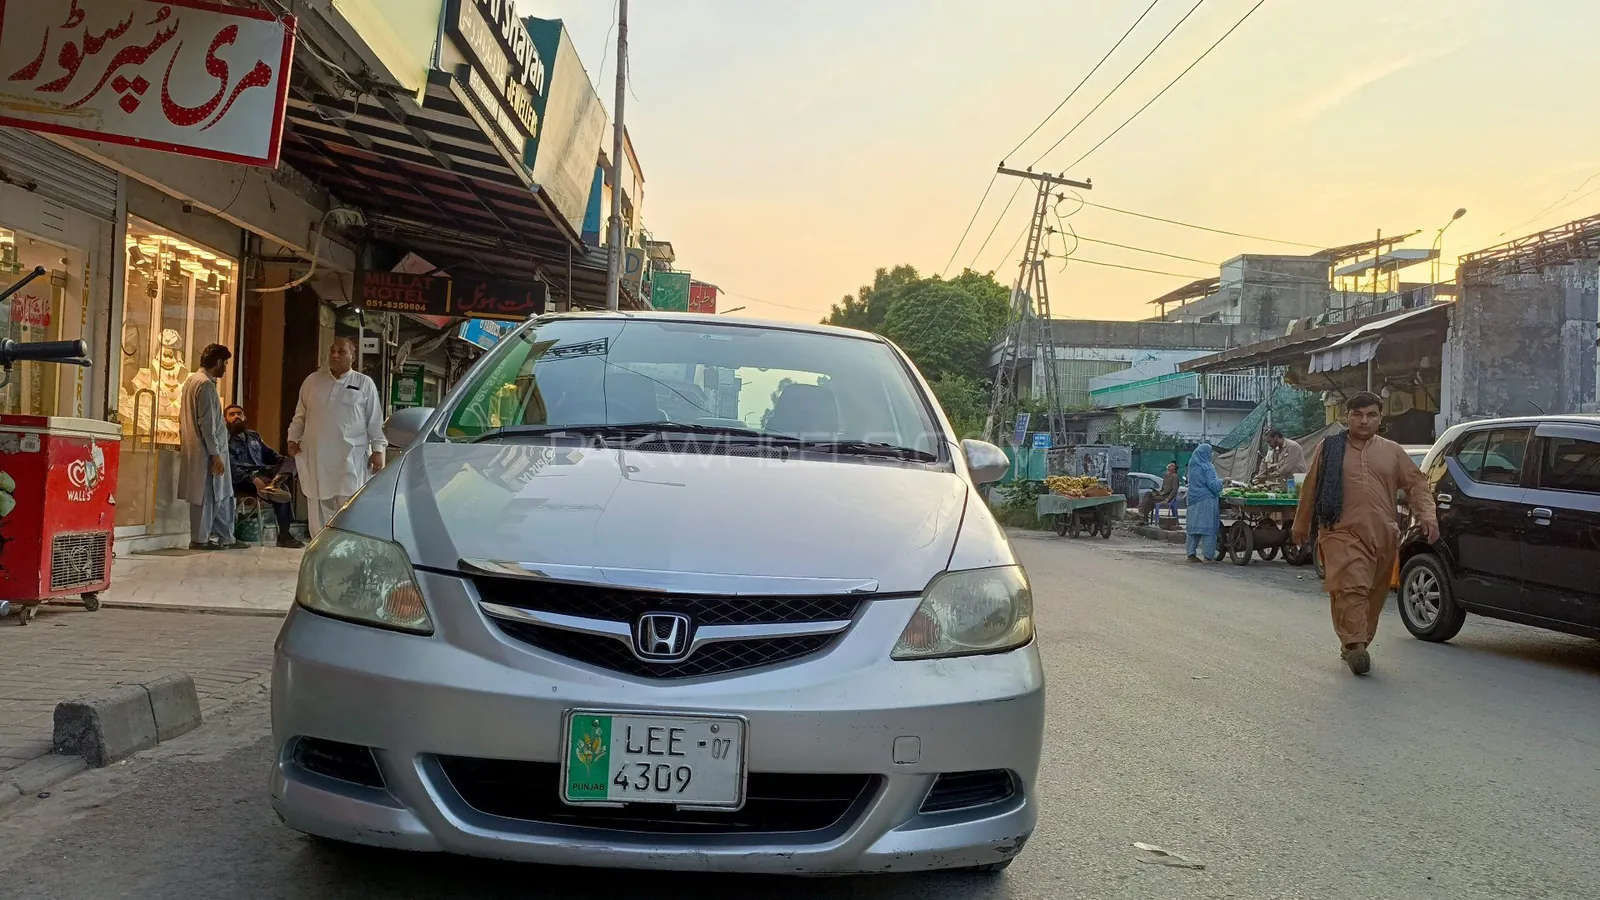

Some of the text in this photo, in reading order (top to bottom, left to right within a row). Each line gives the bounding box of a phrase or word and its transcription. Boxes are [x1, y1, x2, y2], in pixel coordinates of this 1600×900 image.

[161, 24, 272, 131] مری
[364, 286, 428, 303] HOTEL
[366, 271, 434, 290] MILLAT
[76, 251, 92, 419] JEWELERS
[625, 725, 686, 756] LEE
[572, 782, 605, 791] PUNJAB
[613, 763, 692, 793] 4309
